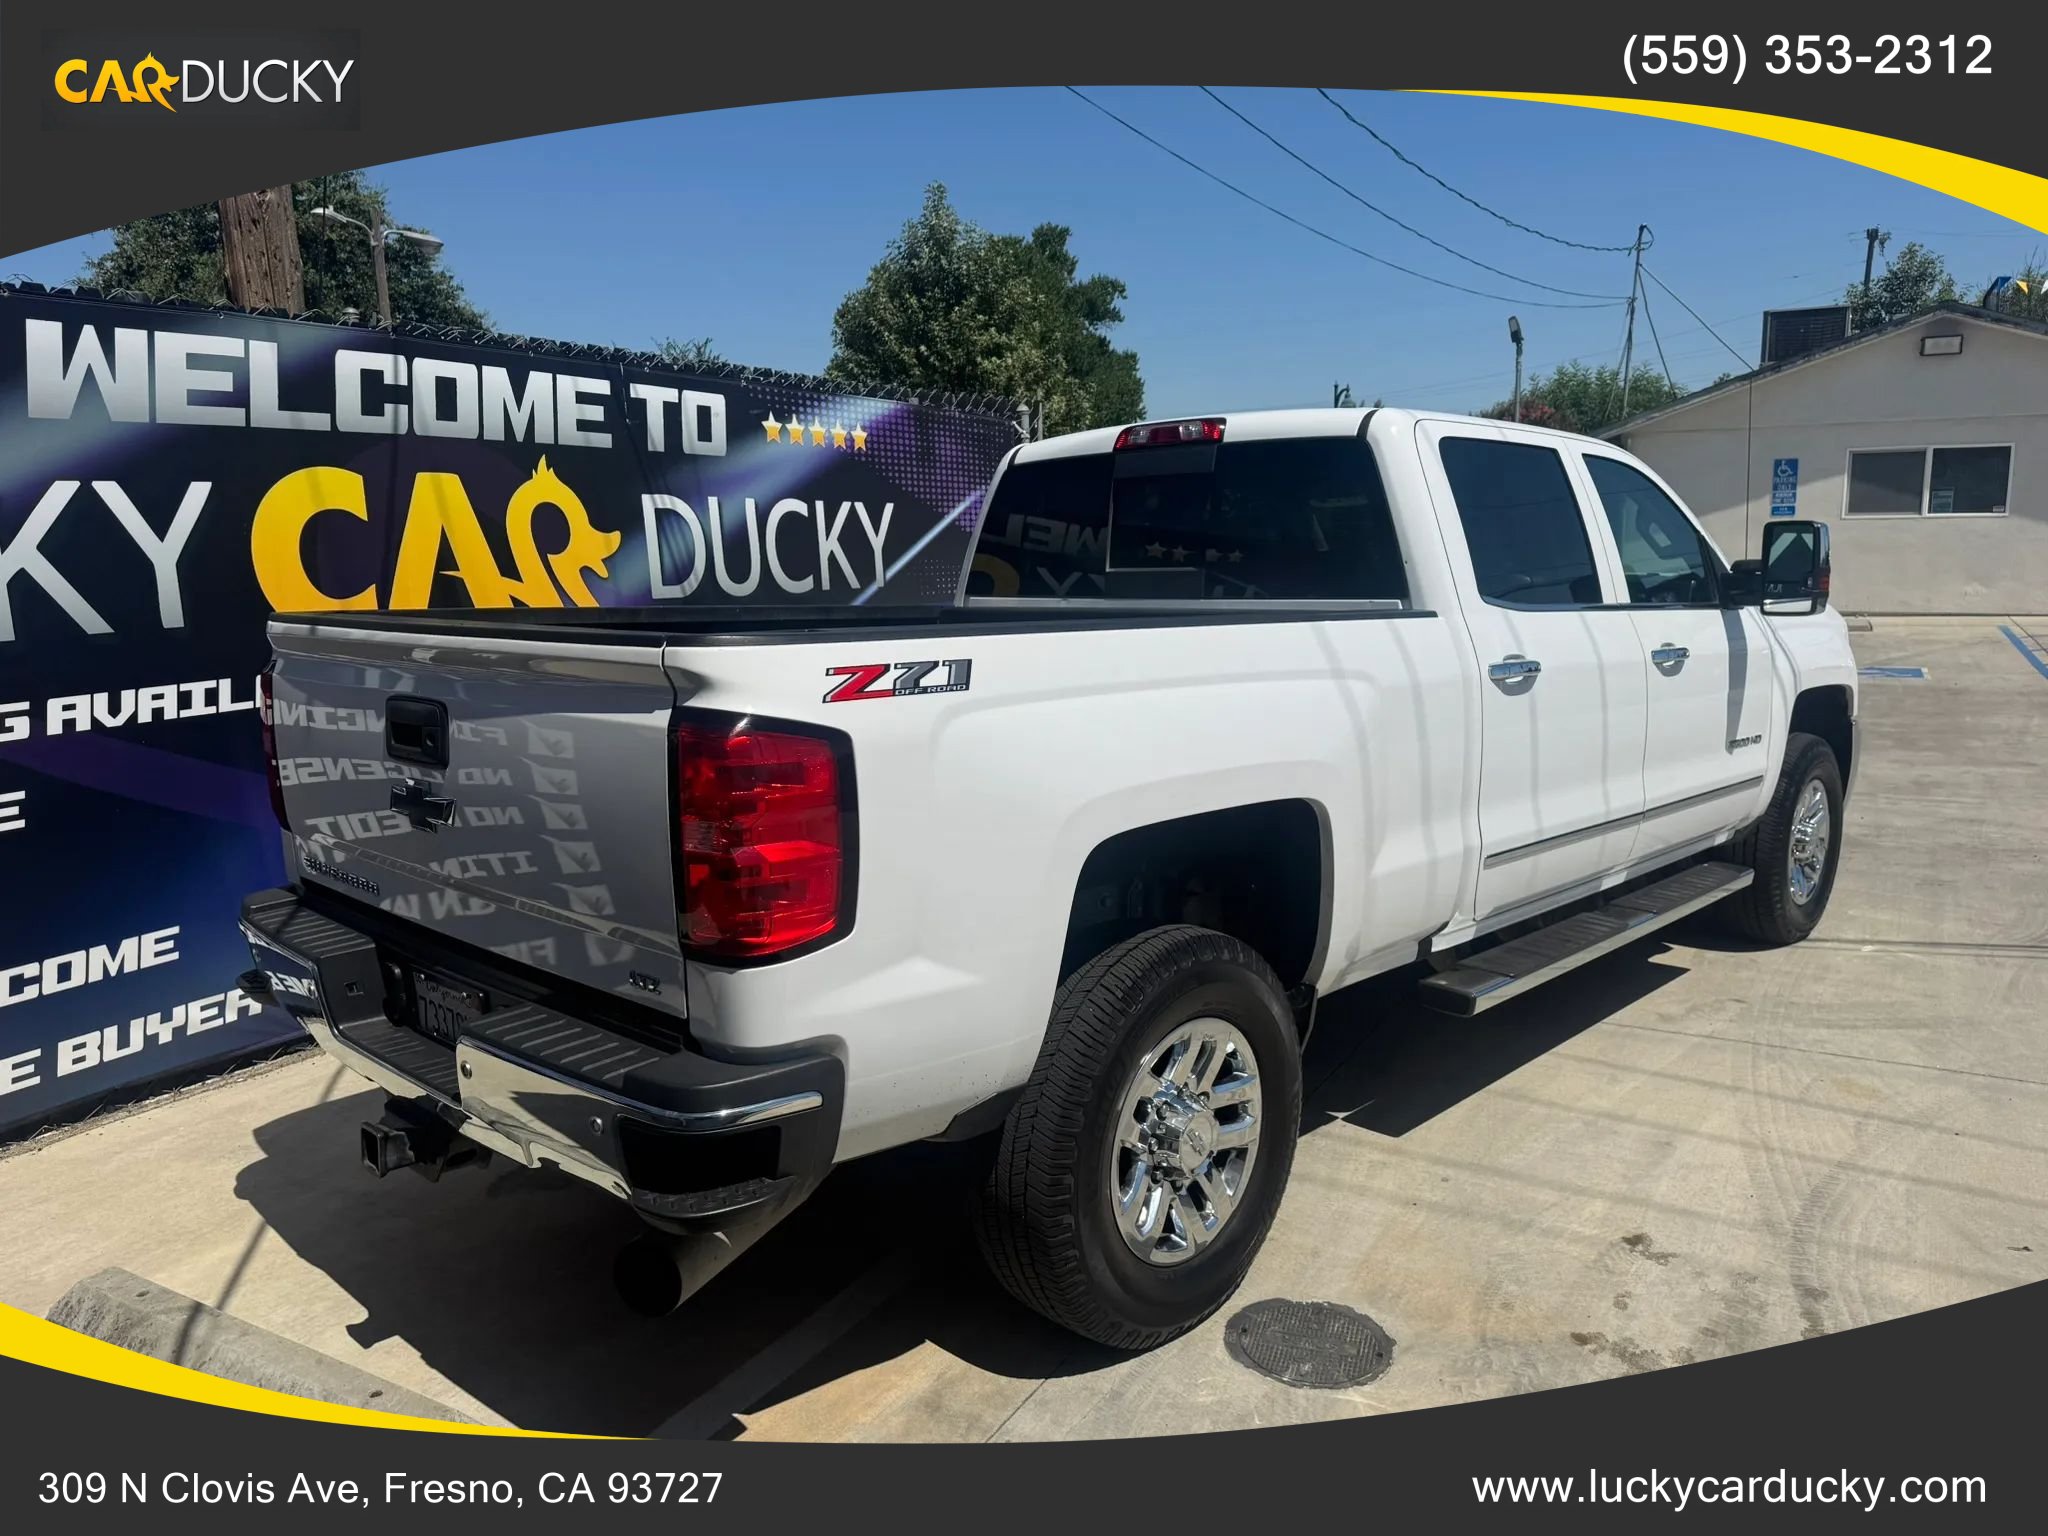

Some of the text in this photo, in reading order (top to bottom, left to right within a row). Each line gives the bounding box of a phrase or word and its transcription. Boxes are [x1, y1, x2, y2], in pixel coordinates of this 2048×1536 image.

[26, 318, 727, 457] WELCOME TO
[251, 455, 621, 611] CAR
[641, 494, 894, 599] DUCKY
[47, 675, 263, 736] AVAIL
[822, 658, 973, 704] Z71
[894, 683, 967, 697] OFF ROAD
[0, 925, 180, 1008] COME
